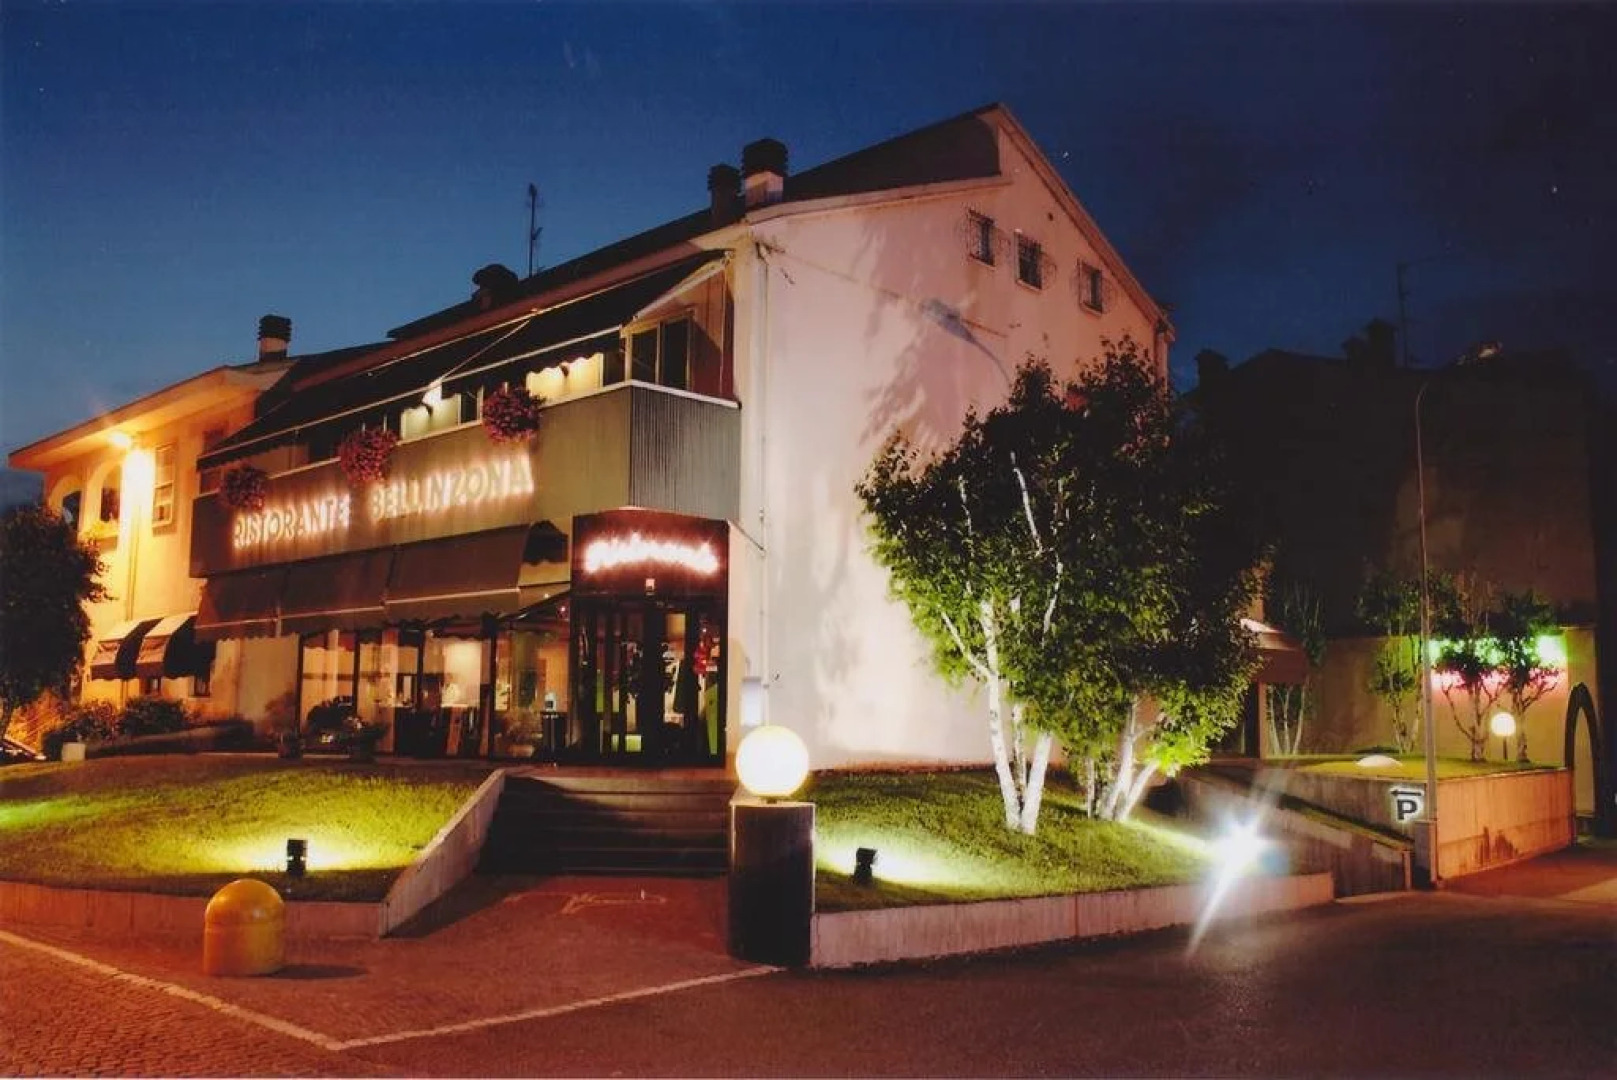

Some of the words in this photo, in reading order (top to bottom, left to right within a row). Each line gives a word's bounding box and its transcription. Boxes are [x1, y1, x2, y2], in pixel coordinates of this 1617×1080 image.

[233, 493, 351, 548] RISTORANTE
[370, 453, 534, 521] BELLINZONA
[1397, 799, 1418, 820] P
